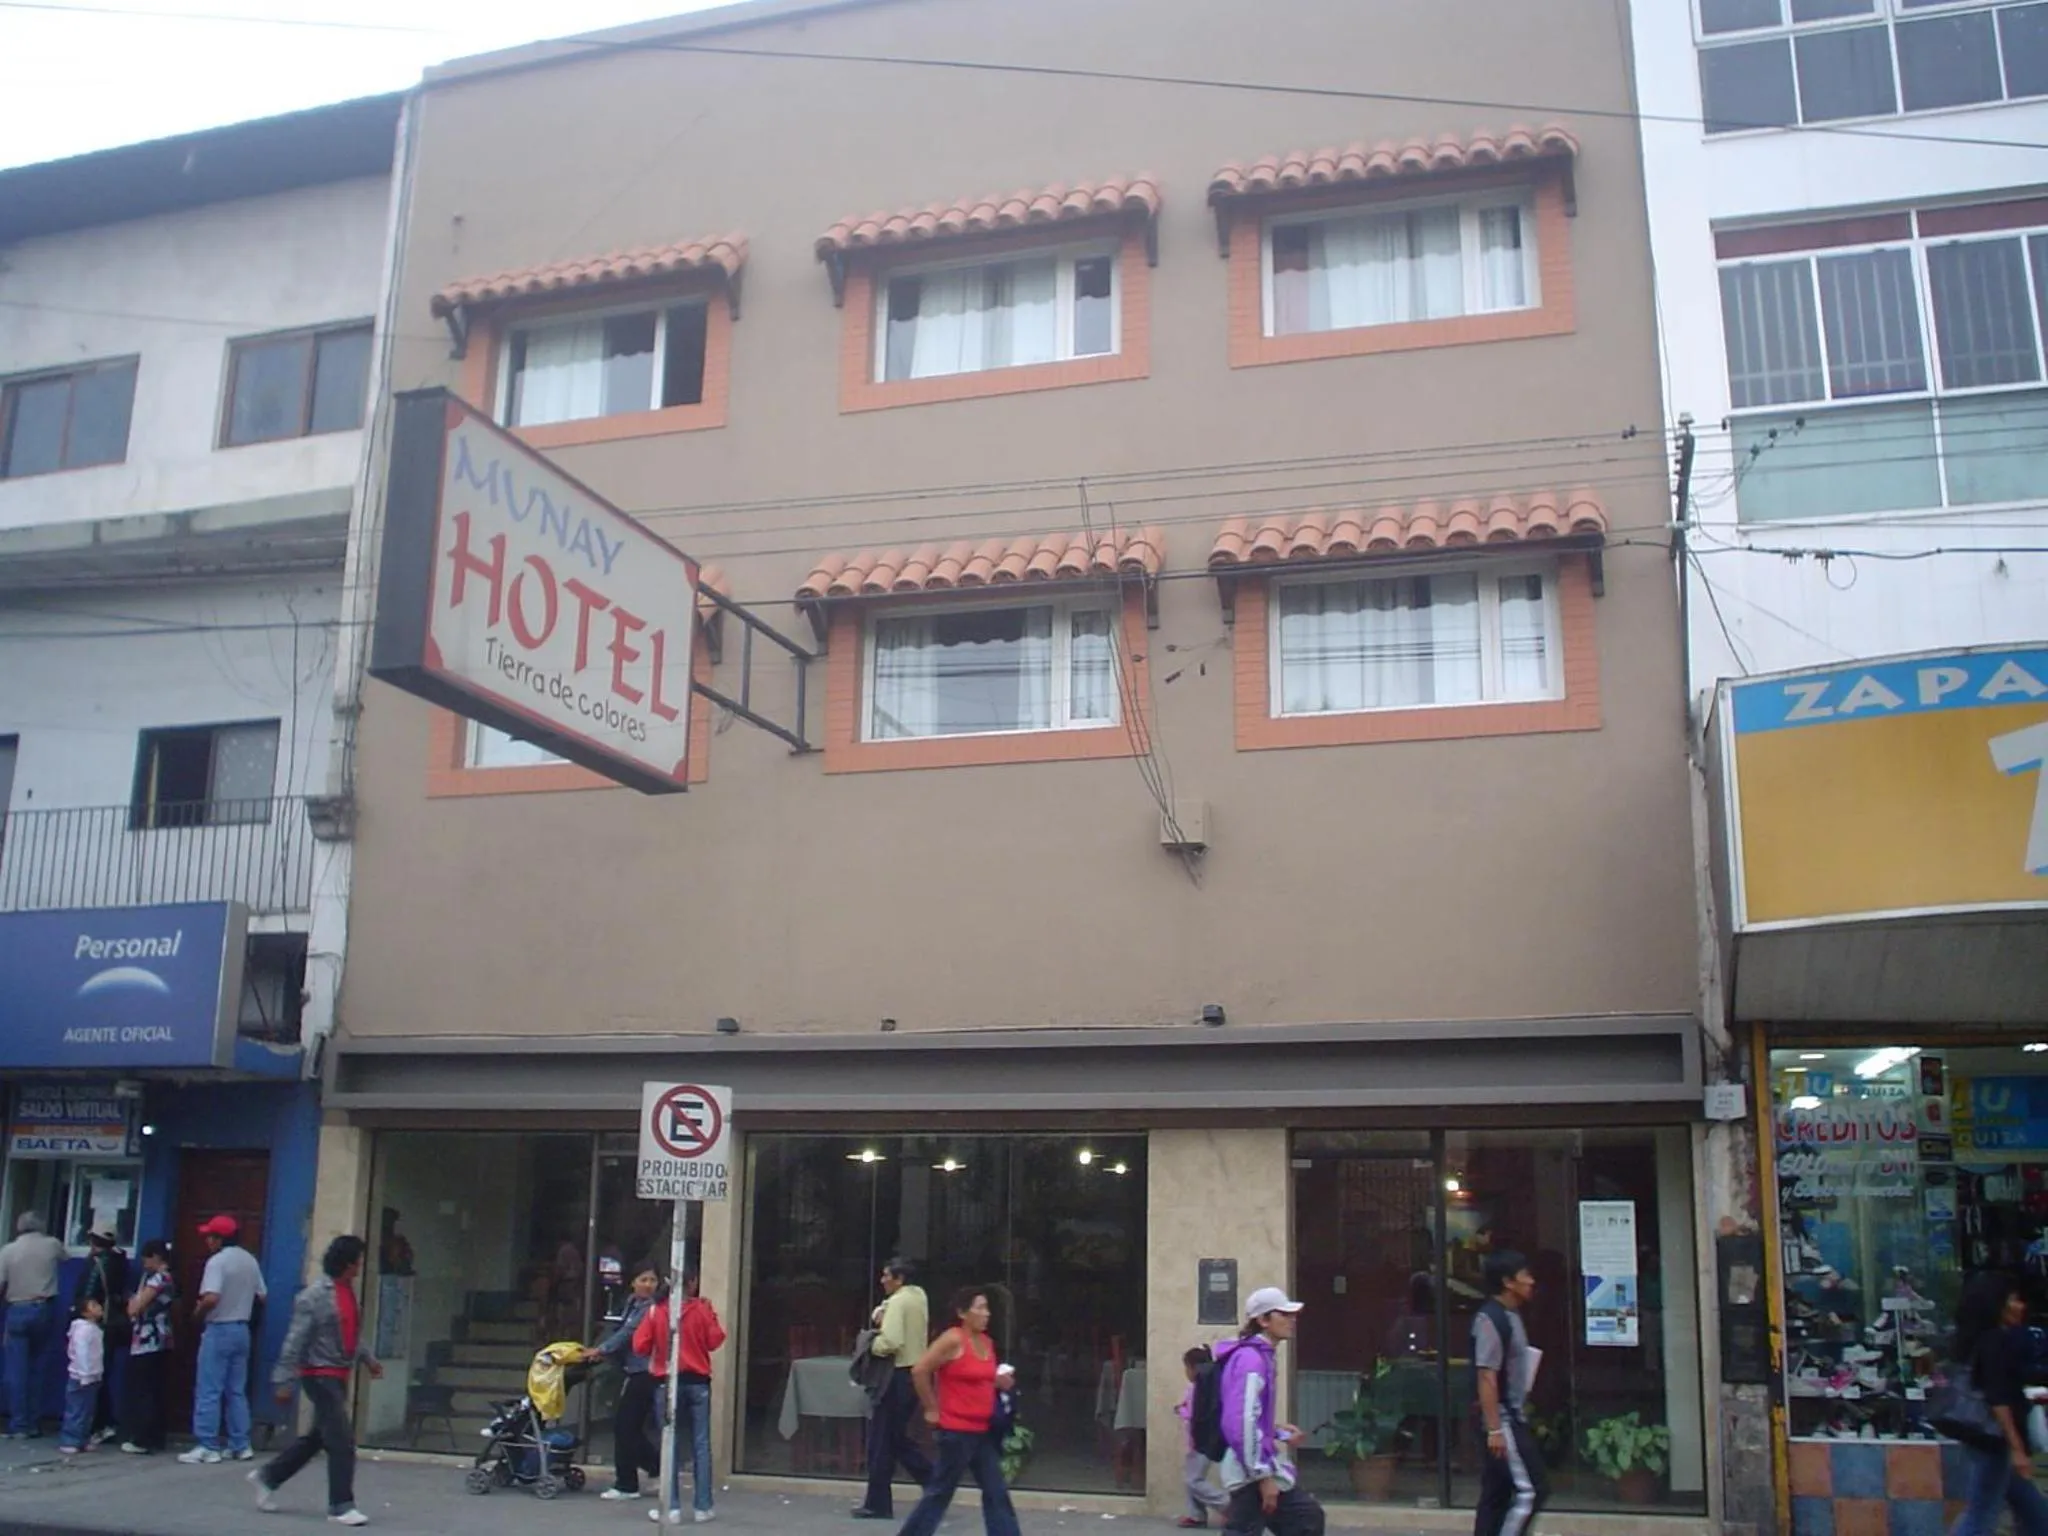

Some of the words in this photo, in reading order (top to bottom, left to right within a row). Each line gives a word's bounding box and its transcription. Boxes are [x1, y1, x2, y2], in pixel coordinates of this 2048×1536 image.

[454, 435, 624, 575] MUNAY
[447, 511, 679, 722] HOTEL
[486, 636, 545, 694] Tierra
[550, 672, 573, 710] de
[1783, 659, 2048, 722] ZAPA
[74, 929, 182, 960] Personal
[63, 1026, 118, 1043] AGENTE
[120, 1025, 175, 1042] OFICIAL
[637, 1178, 728, 1197] ESTACIOAR
[641, 1160, 725, 1179] PROHIBIDO
